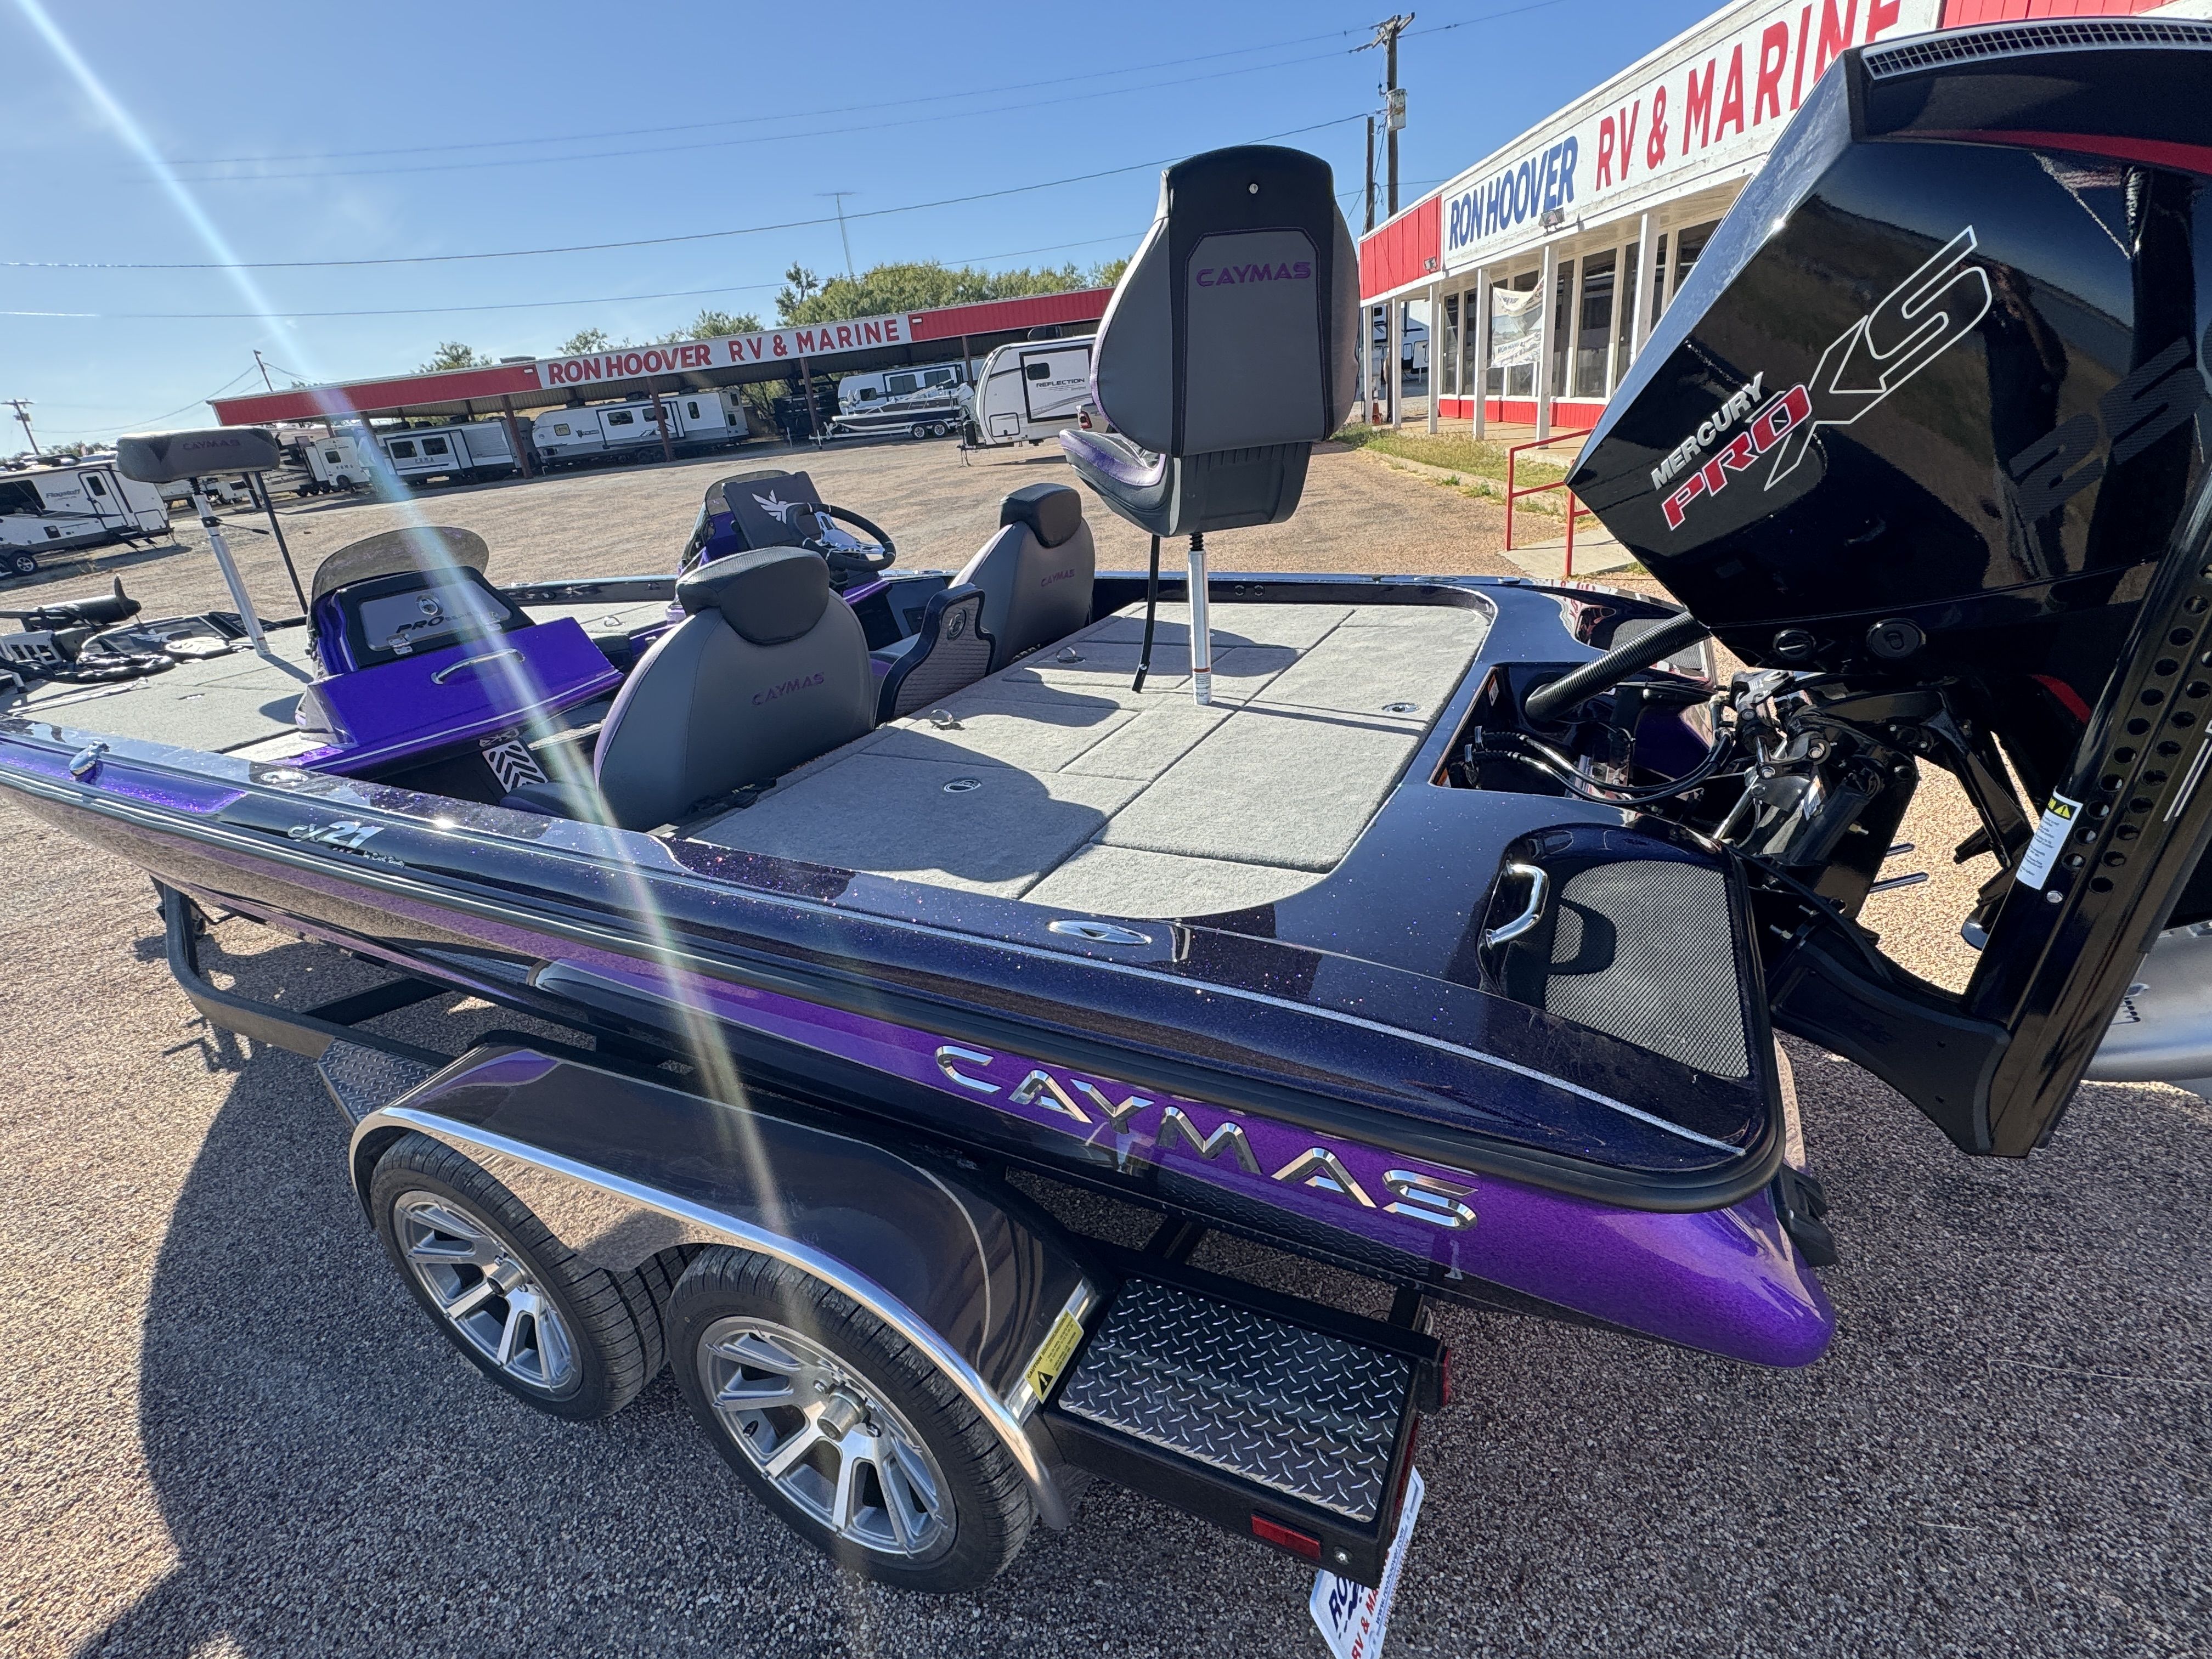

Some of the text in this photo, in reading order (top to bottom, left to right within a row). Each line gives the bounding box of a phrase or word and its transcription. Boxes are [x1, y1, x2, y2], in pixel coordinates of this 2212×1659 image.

[1449, 185, 1485, 251] RON
[1485, 136, 1578, 237] HOOVER
[1596, 99, 1640, 192] RV
[1647, 85, 1668, 170] &
[1196, 262, 1311, 287] CAYMAS
[548, 319, 900, 385] RON HOOVER RV & MARINE
[1036, 378, 1085, 388] REFLECTION
[1661, 224, 1993, 531] PRO XS
[183, 439, 241, 450] CAYMAS
[1650, 371, 1764, 490] MERCURY
[1040, 569, 1075, 587] CAYMAS
[396, 616, 444, 634] PRO
[752, 672, 824, 706] CAYMAS
[934, 1045, 1479, 1231] CAYMAS
[1027, 1356, 1042, 1379] CAUTION
